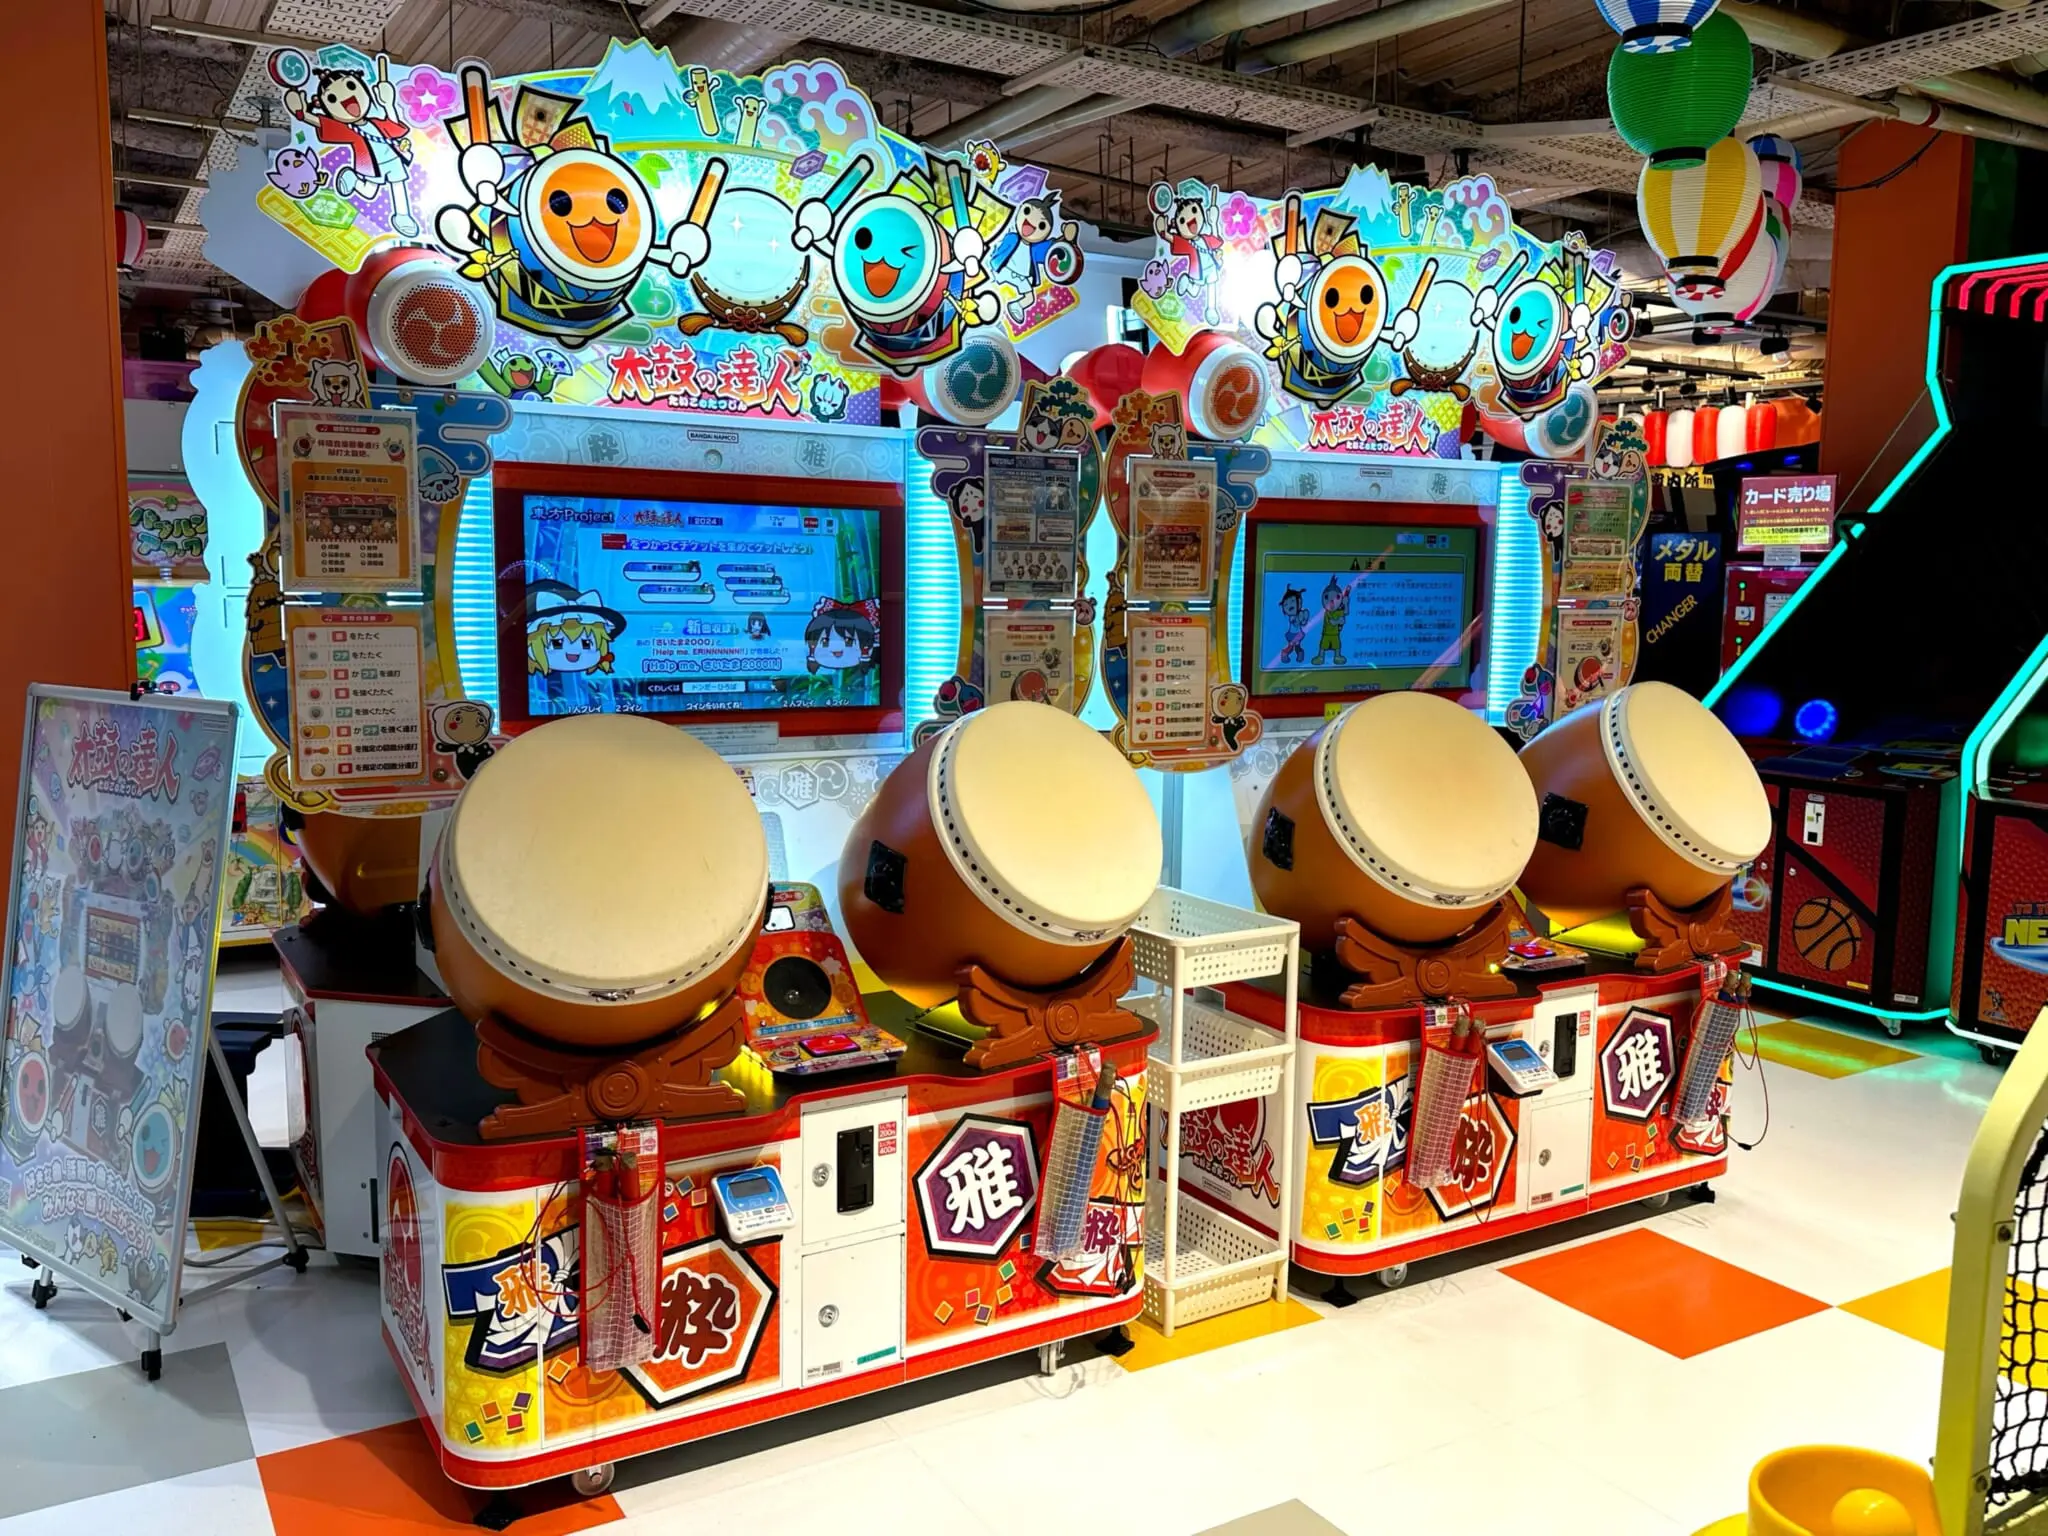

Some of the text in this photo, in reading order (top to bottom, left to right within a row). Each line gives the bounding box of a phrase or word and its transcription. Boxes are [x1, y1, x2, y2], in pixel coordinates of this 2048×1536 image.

[608, 339, 801, 414] 太鼓の達人
[668, 396, 748, 412] たいこのたつじん
[1309, 402, 1430, 454] 太鼓の達人
[802, 439, 828, 468] 雅
[1744, 484, 1831, 504] カード売り場
[531, 506, 615, 524] 東方Project
[694, 517, 718, 526] 2024
[1655, 539, 1716, 562] メダル
[1663, 563, 1704, 583] 両替
[1645, 594, 1698, 645] CHANGER
[350, 632, 380, 641] をたたく
[352, 651, 383, 659] をたたく
[648, 683, 680, 692] くわしくは
[568, 704, 601, 714] 1人プレイ
[68, 719, 180, 803] 太鼓の達人
[786, 771, 813, 800] 雅
[1615, 1028, 1665, 1100] 雅
[1355, 1102, 1393, 1144] 雅
[939, 1141, 1024, 1235] 雅
[493, 1261, 556, 1318] 雅
